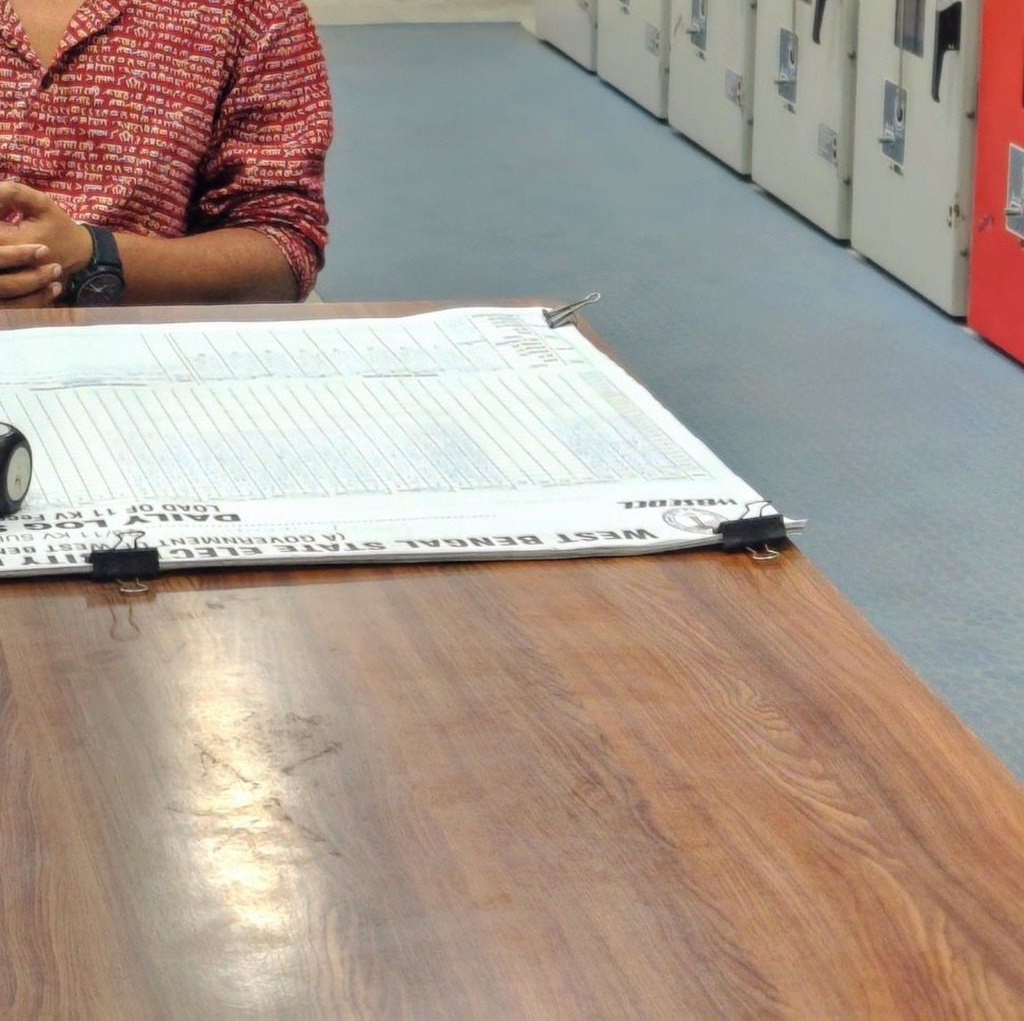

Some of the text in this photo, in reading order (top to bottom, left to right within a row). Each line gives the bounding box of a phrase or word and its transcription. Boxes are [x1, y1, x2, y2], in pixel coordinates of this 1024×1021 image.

[92, 508, 117, 518] 11
[126, 505, 153, 514] OF
[162, 504, 221, 513] LOAD
[55, 511, 83, 521] KV
[122, 513, 242, 526] DAILY
[23, 520, 109, 531] LOG
[158, 534, 316, 547] GOVERNMENT
[395, 534, 545, 549] BENGAL
[555, 529, 659, 544] WEST
[279, 541, 387, 554] STATE
